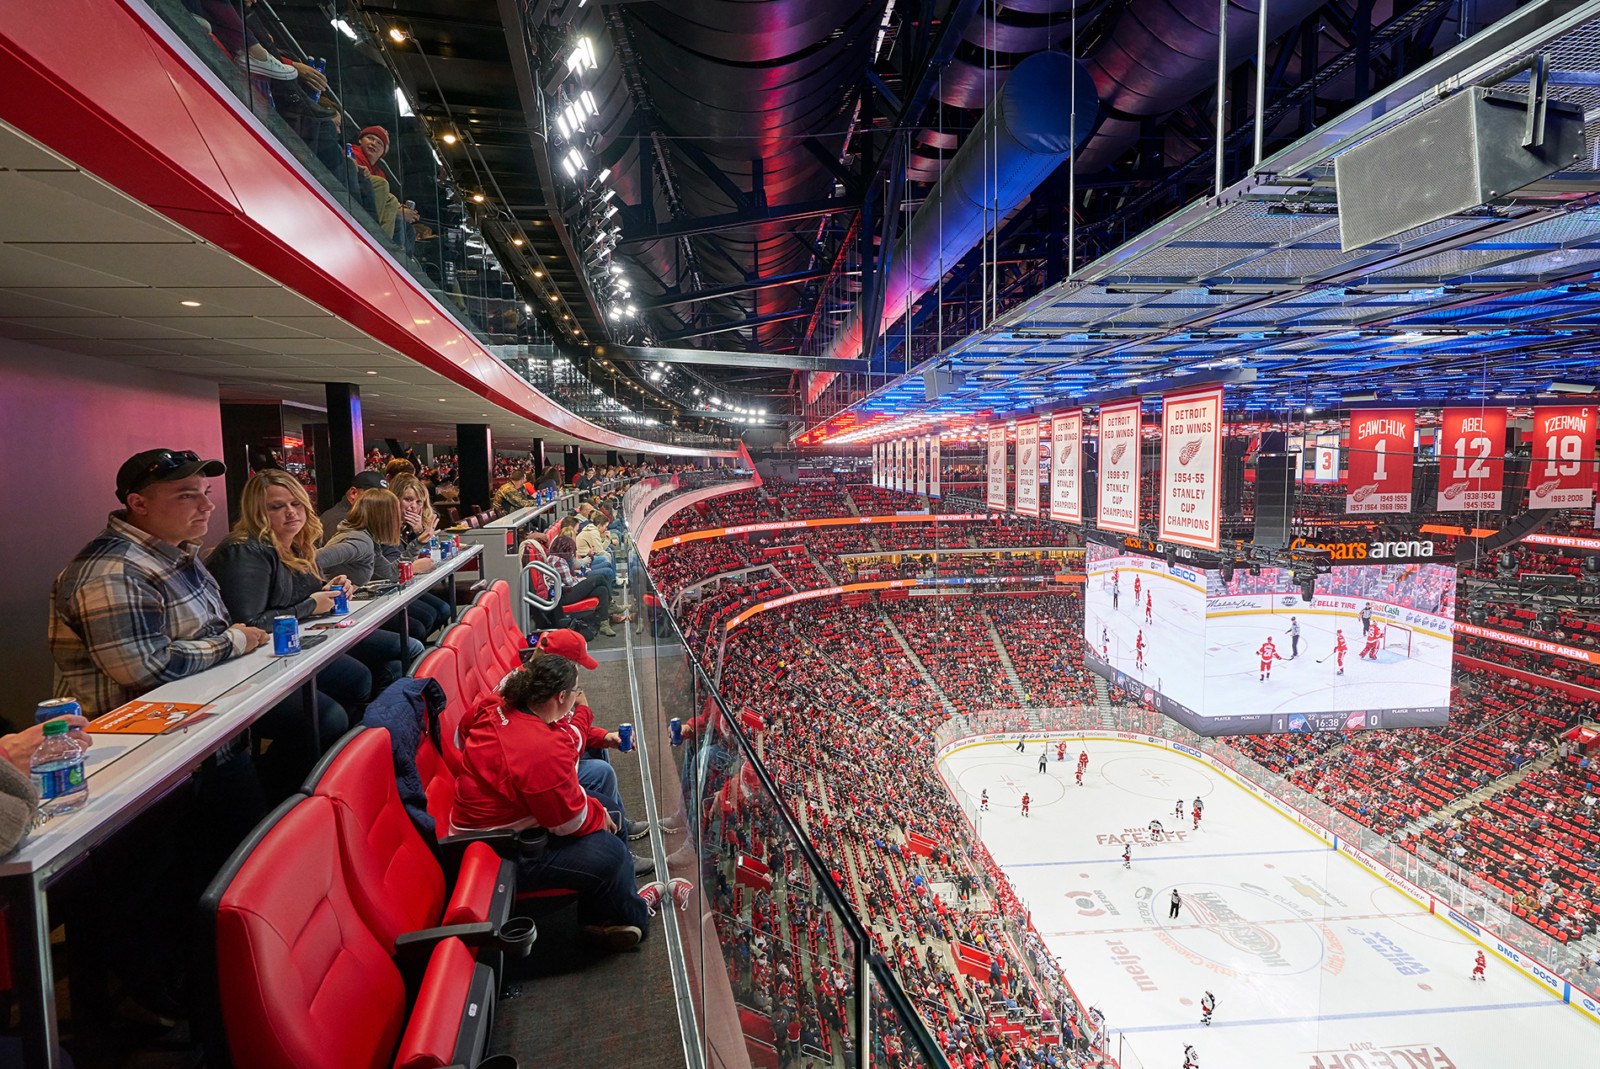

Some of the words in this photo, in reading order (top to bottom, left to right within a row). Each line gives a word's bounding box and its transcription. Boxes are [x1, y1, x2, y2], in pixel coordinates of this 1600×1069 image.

[1175, 408, 1206, 420] DETROIT
[1582, 408, 1588, 417] C
[1058, 422, 1074, 431] DETROIT
[1108, 416, 1130, 426] DETROIT
[1170, 425, 1184, 434] RED
[1187, 422, 1212, 434] WINGS
[1462, 418, 1486, 433] ABEL
[1544, 416, 1586, 433] YZERMAN
[1105, 430, 1114, 439] RED
[1116, 429, 1134, 438] WINGS
[1358, 419, 1406, 440] SAWCHUK
[1322, 452, 1332, 470] 3
[1373, 439, 1387, 480] 1
[1453, 437, 1492, 478] 12
[1544, 435, 1582, 477] 19
[1107, 471, 1129, 479] 1996-97
[1174, 473, 1204, 483] 1954-55
[1106, 484, 1129, 493] STANLEY
[1172, 488, 1205, 499] STANLEY
[1055, 501, 1077, 509] CHAMPIONS
[1112, 496, 1123, 504] CUP
[1180, 502, 1196, 513] CUP
[1103, 507, 1133, 518] CHAMPIONS
[1168, 515, 1209, 530] CHAMPIONS
[1527, 534, 1556, 543] XFINITY
[1557, 537, 1574, 545] WIFI
[1370, 540, 1434, 558] arena
[1169, 567, 1196, 582] GEICO
[1466, 626, 1480, 635] WIFI
[1482, 629, 1537, 649] THROUGHOUT
[1539, 642, 1555, 652] THE
[1557, 647, 1589, 661] ARENA
[1112, 672, 1116, 681] 1
[1156, 696, 1160, 707] 0
[1277, 719, 1283, 730] 1
[1316, 719, 1339, 727] 16:38
[1370, 715, 1378, 726] 0
[1173, 743, 1201, 758] GEICO
[1342, 842, 1353, 856] Tim
[1353, 849, 1377, 871] Hortons
[1384, 870, 1425, 900] Budweiser
[1093, 890, 1120, 915] BELFOR
[1274, 894, 1312, 918] arena
[1138, 901, 1154, 925] arena
[1155, 932, 1204, 966] Caesars
[1362, 937, 1417, 976] Burns
[1369, 931, 1430, 974] Wilcox
[1104, 940, 1158, 991] meijer
[1497, 944, 1519, 962] DMC
[1533, 967, 1557, 987] DOCS
[1350, 1041, 1376, 1051] 2017
